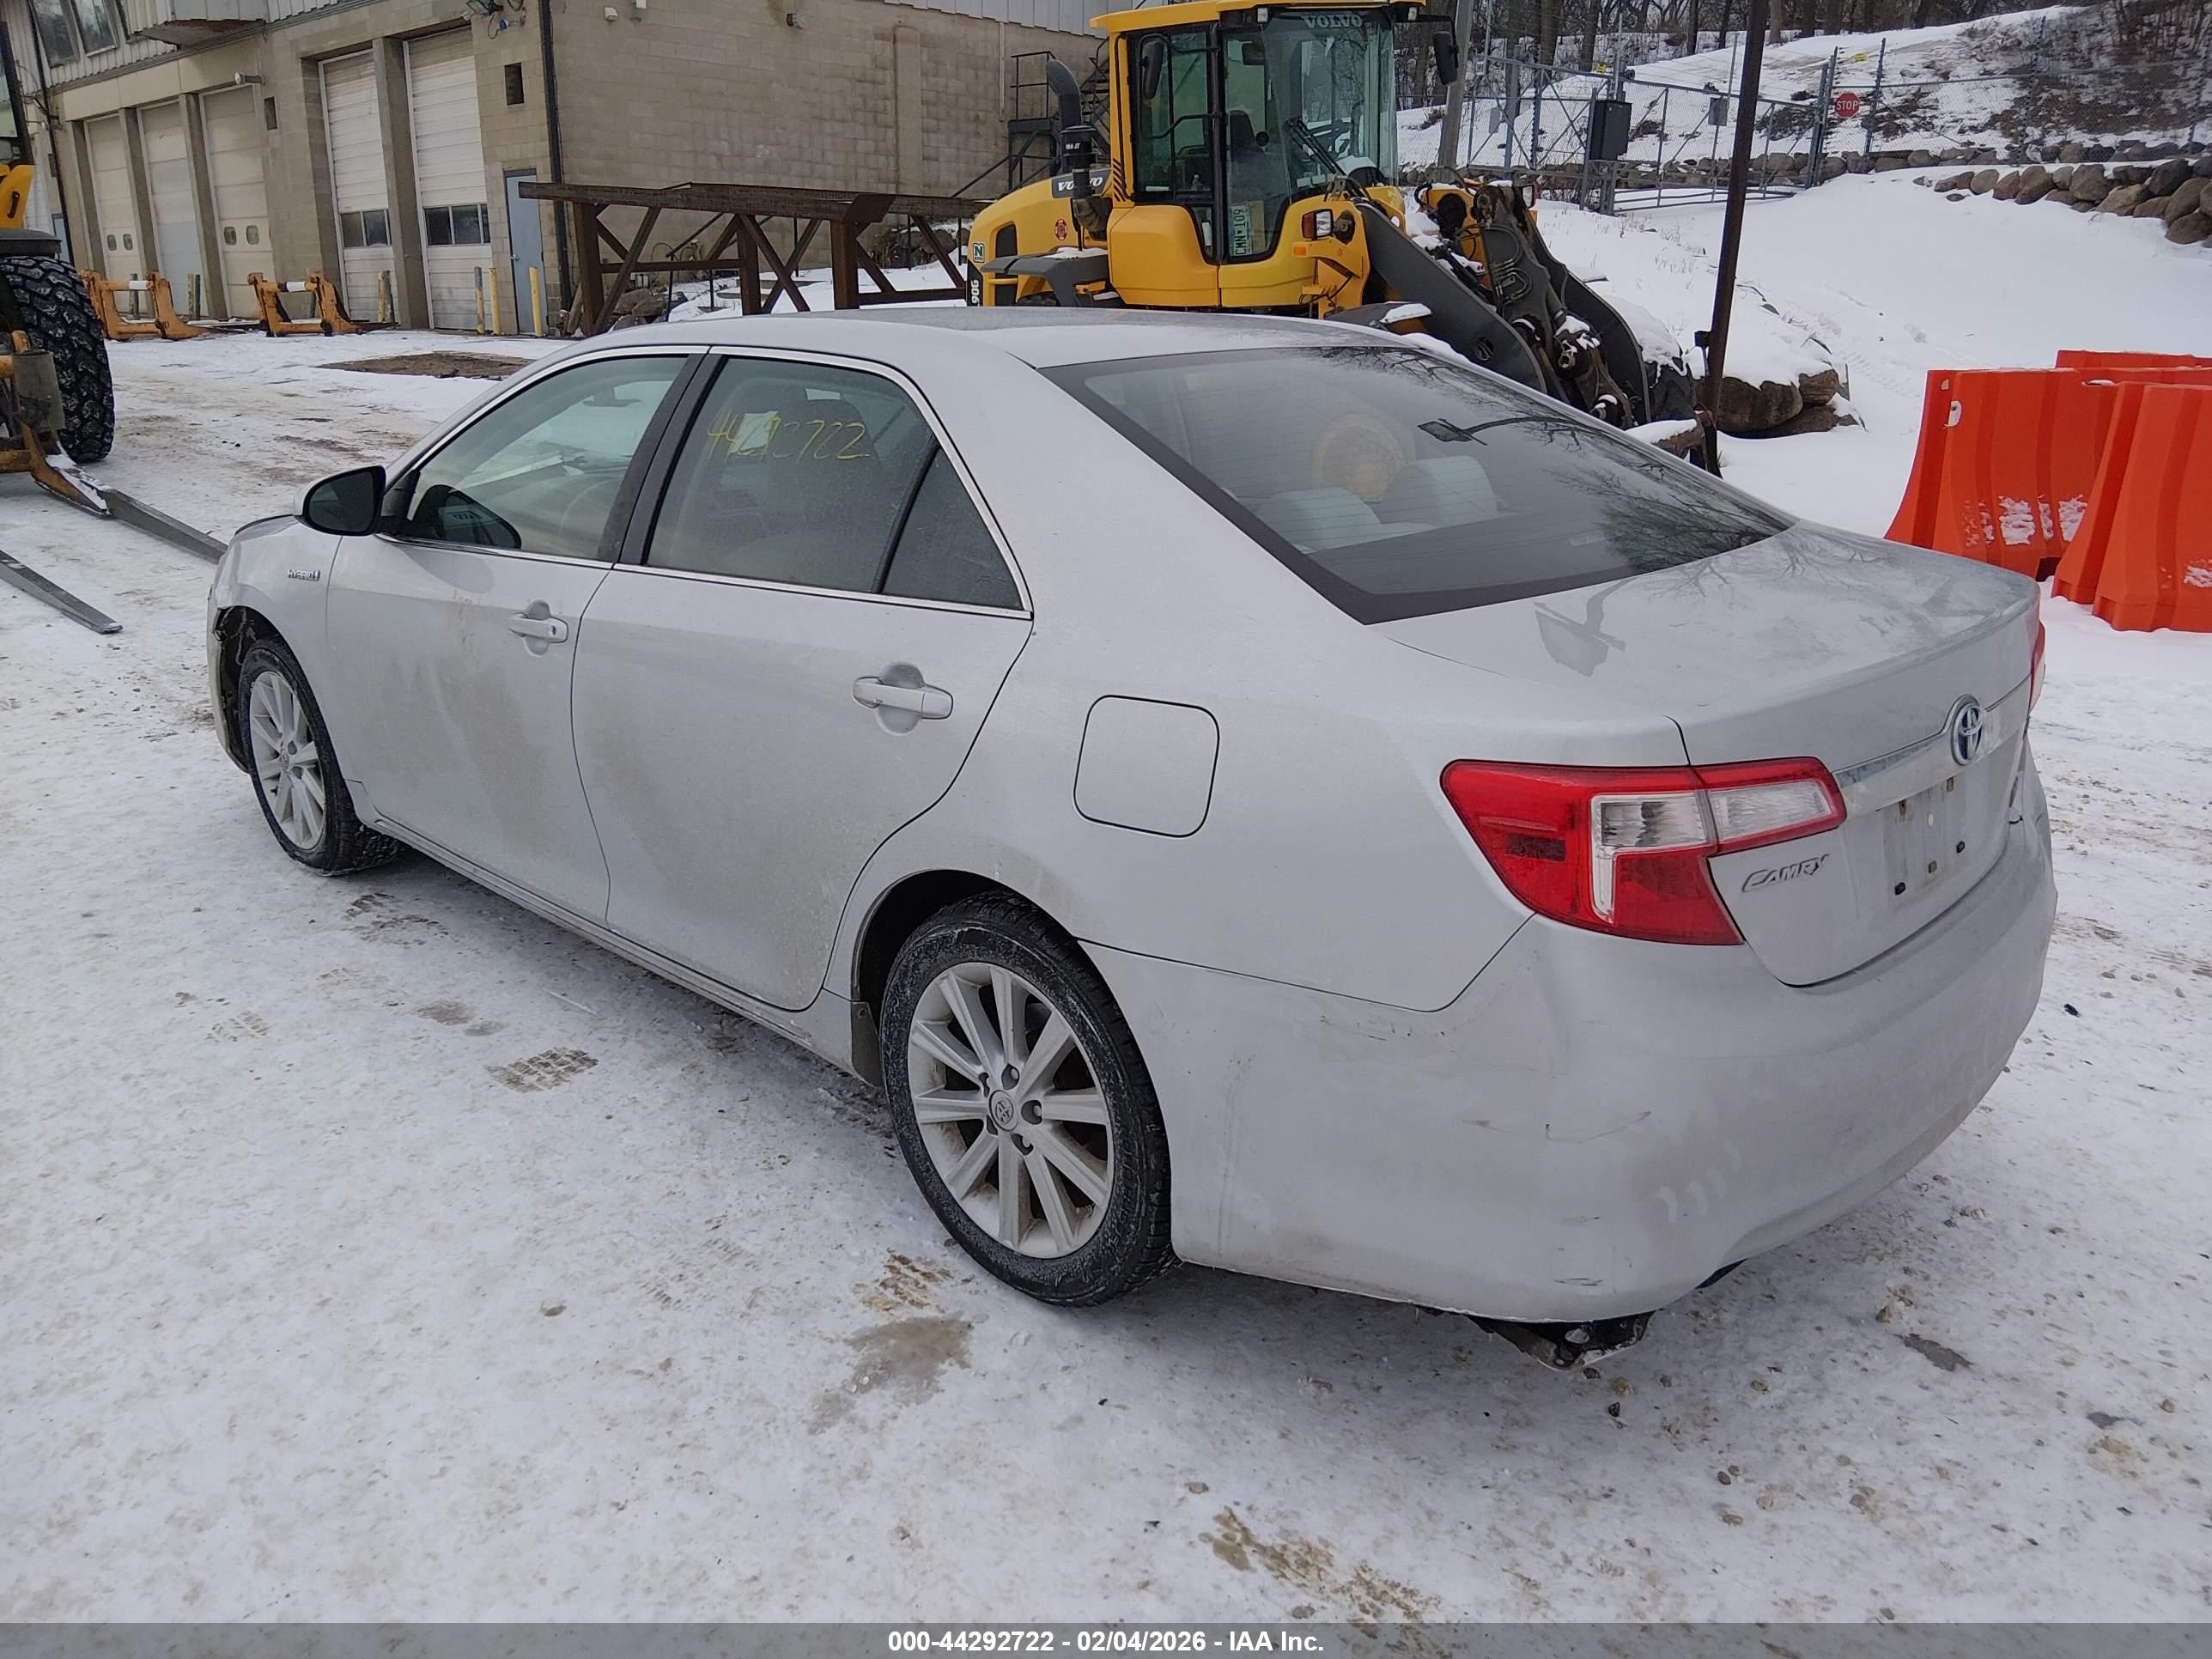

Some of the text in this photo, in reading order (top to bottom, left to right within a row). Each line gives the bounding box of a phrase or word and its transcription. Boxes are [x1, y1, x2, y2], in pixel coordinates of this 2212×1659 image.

[1301, 14, 1363, 28] VOLVO
[1836, 100, 1859, 111] STOP
[1058, 177, 1103, 191] VOO
[1233, 209, 1247, 255] CMN 109
[974, 246, 983, 257] N
[971, 279, 981, 307] 90G
[1741, 854, 1830, 893] CAMRY
